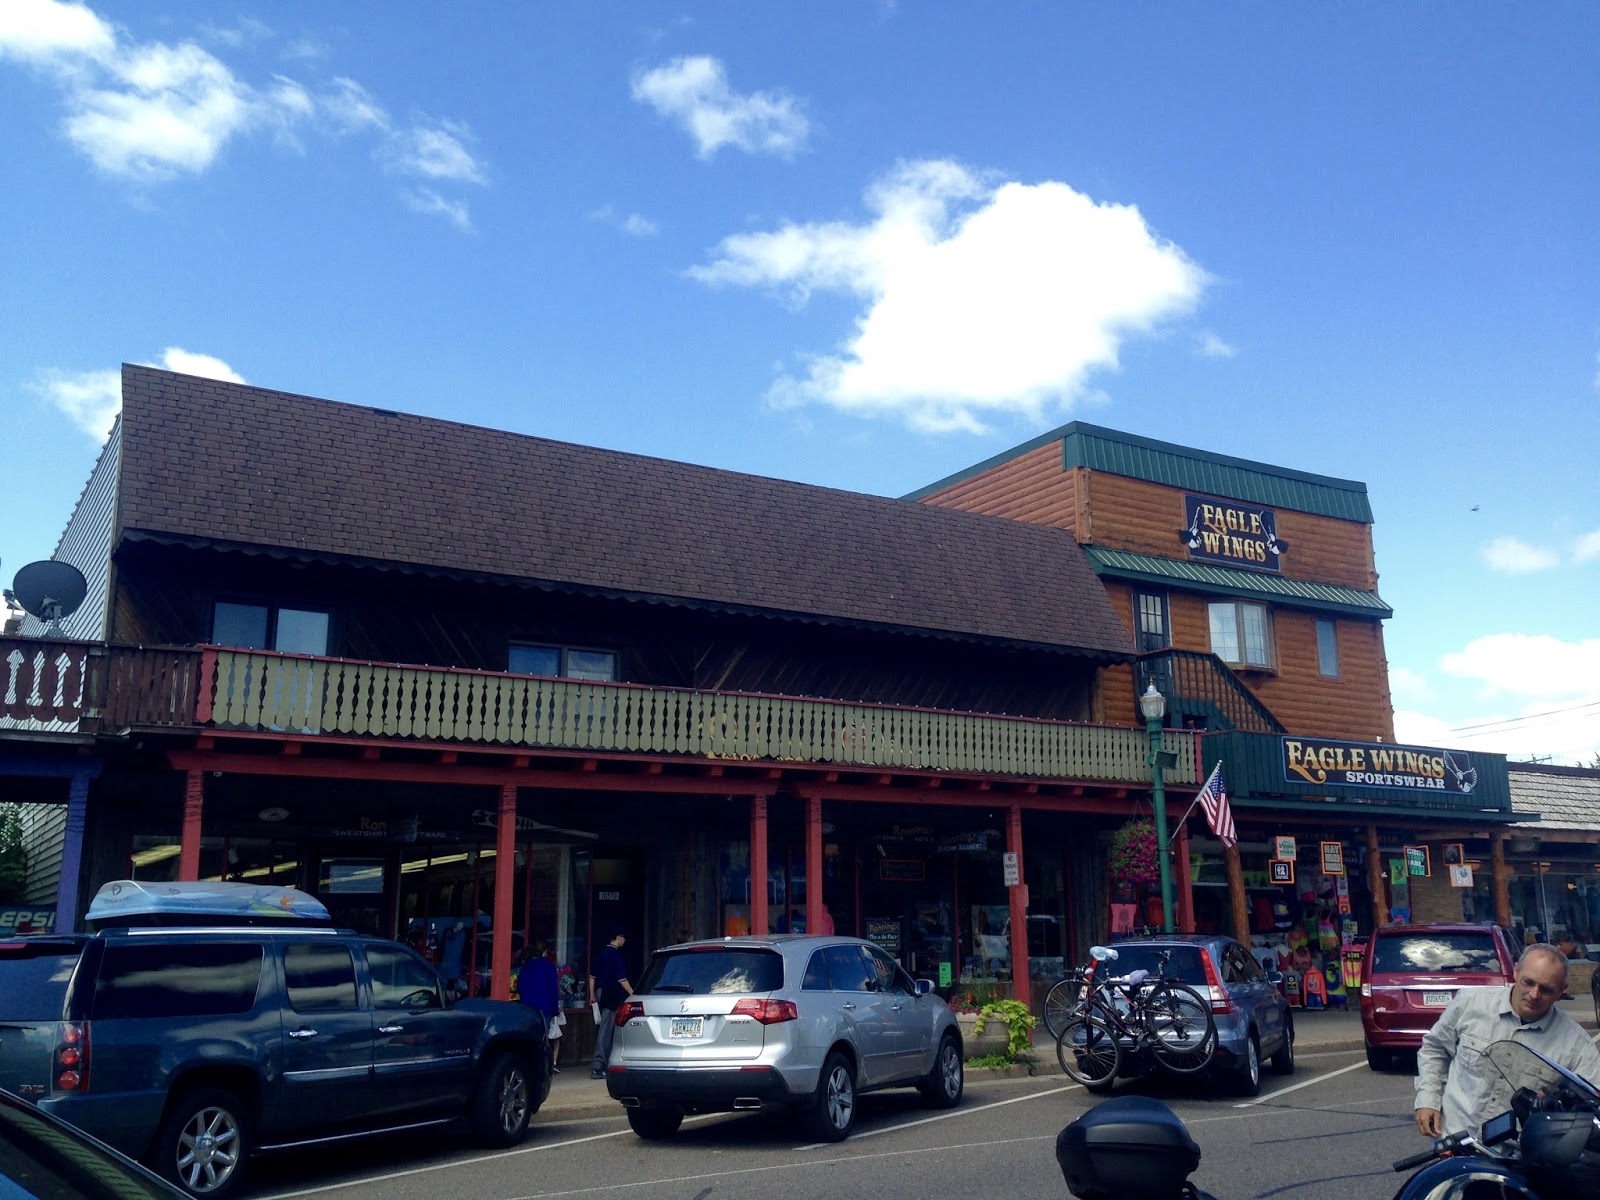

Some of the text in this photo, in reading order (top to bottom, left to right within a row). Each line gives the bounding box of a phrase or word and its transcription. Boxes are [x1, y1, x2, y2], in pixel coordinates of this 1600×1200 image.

[1202, 504, 1261, 535] EAGLE
[1202, 531, 1267, 562] WINGS
[1286, 741, 1445, 784] EAGLE WINGS
[1346, 770, 1445, 789] SPORTSWEAR
[0, 911, 56, 927] EPSI
